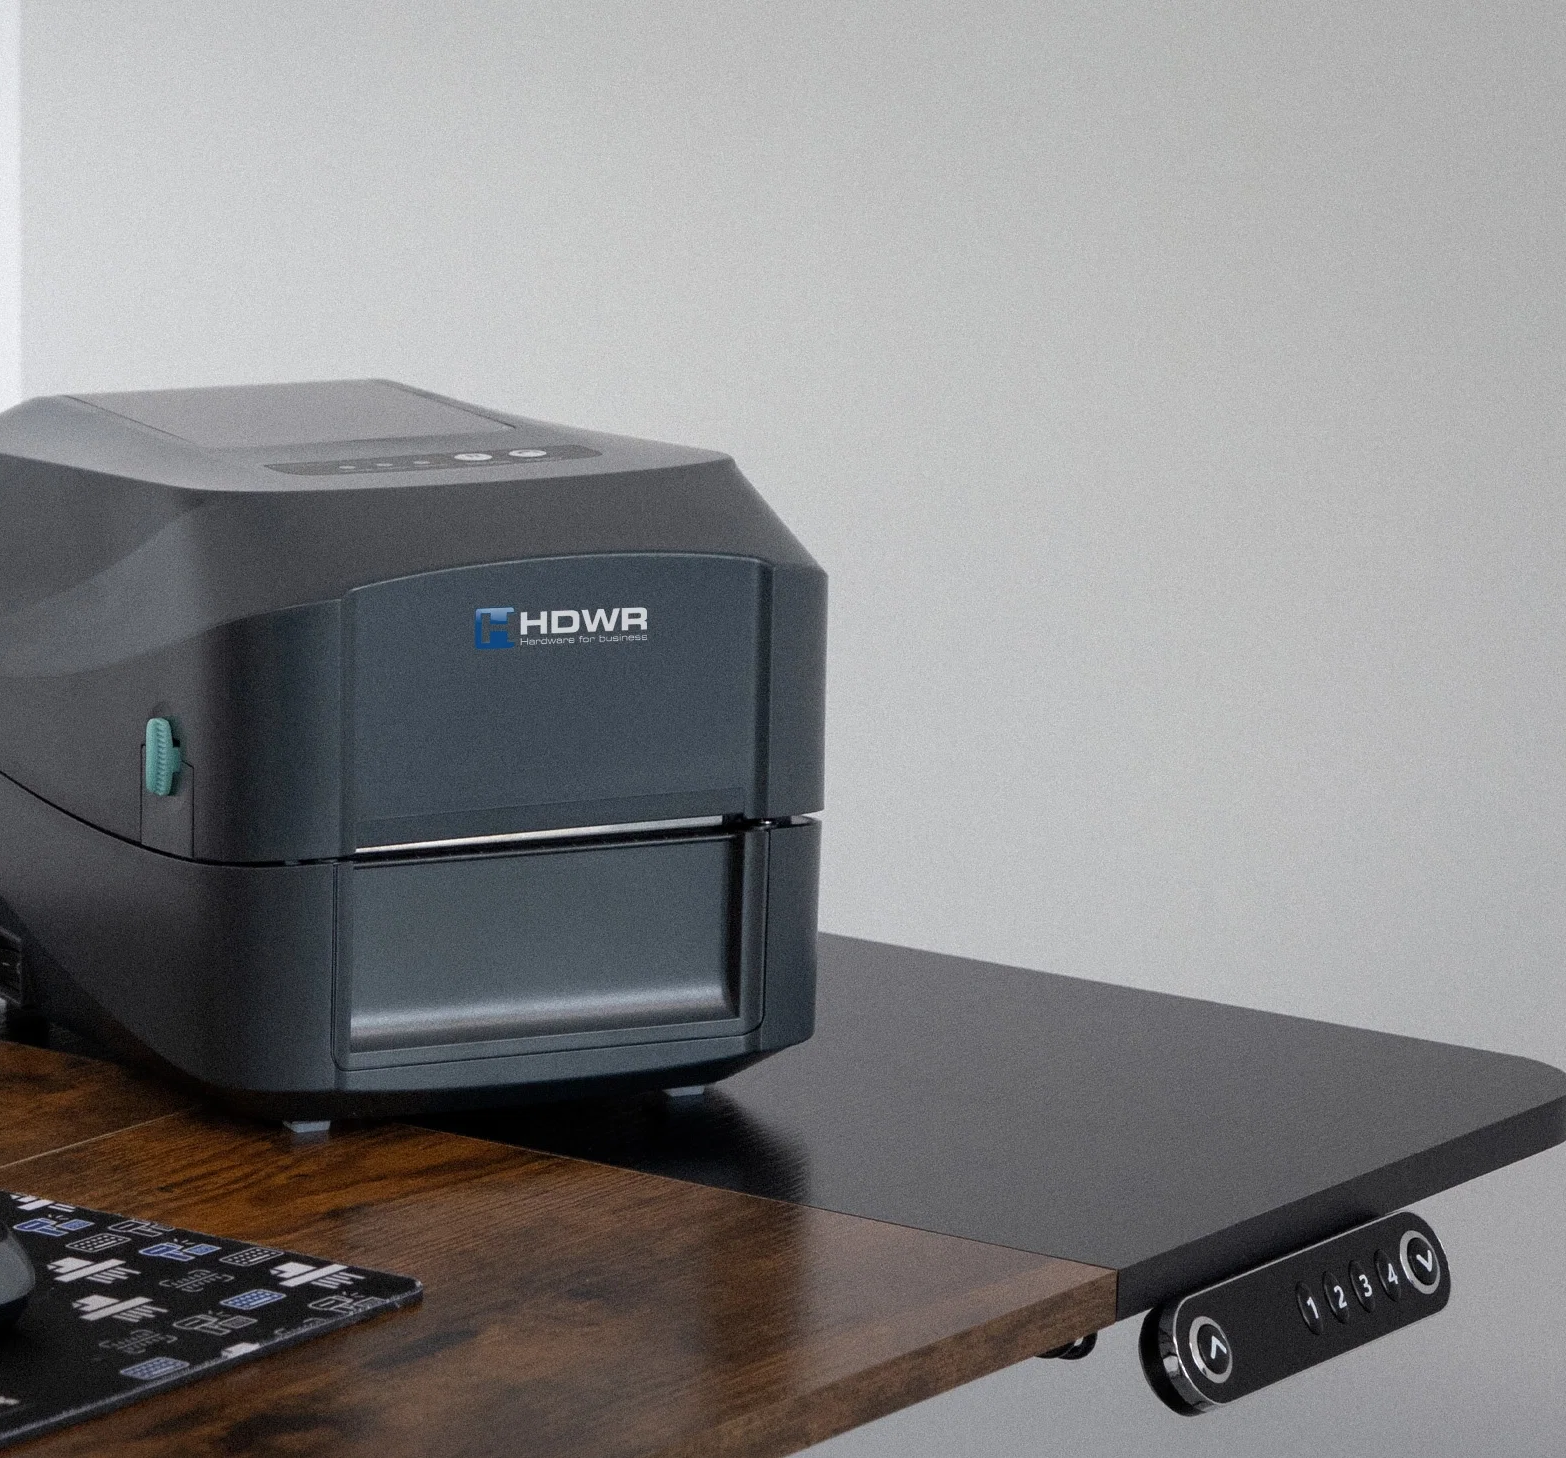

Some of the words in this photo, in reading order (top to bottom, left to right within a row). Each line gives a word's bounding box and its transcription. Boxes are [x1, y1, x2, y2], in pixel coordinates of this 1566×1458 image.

[520, 607, 648, 635] HDWR
[520, 637, 575, 646] Hardware
[599, 634, 648, 643] business
[1307, 1296, 1319, 1318] 1
[1334, 1285, 1348, 1309] 2
[1358, 1274, 1373, 1297] 3
[1388, 1263, 1399, 1285] 4
